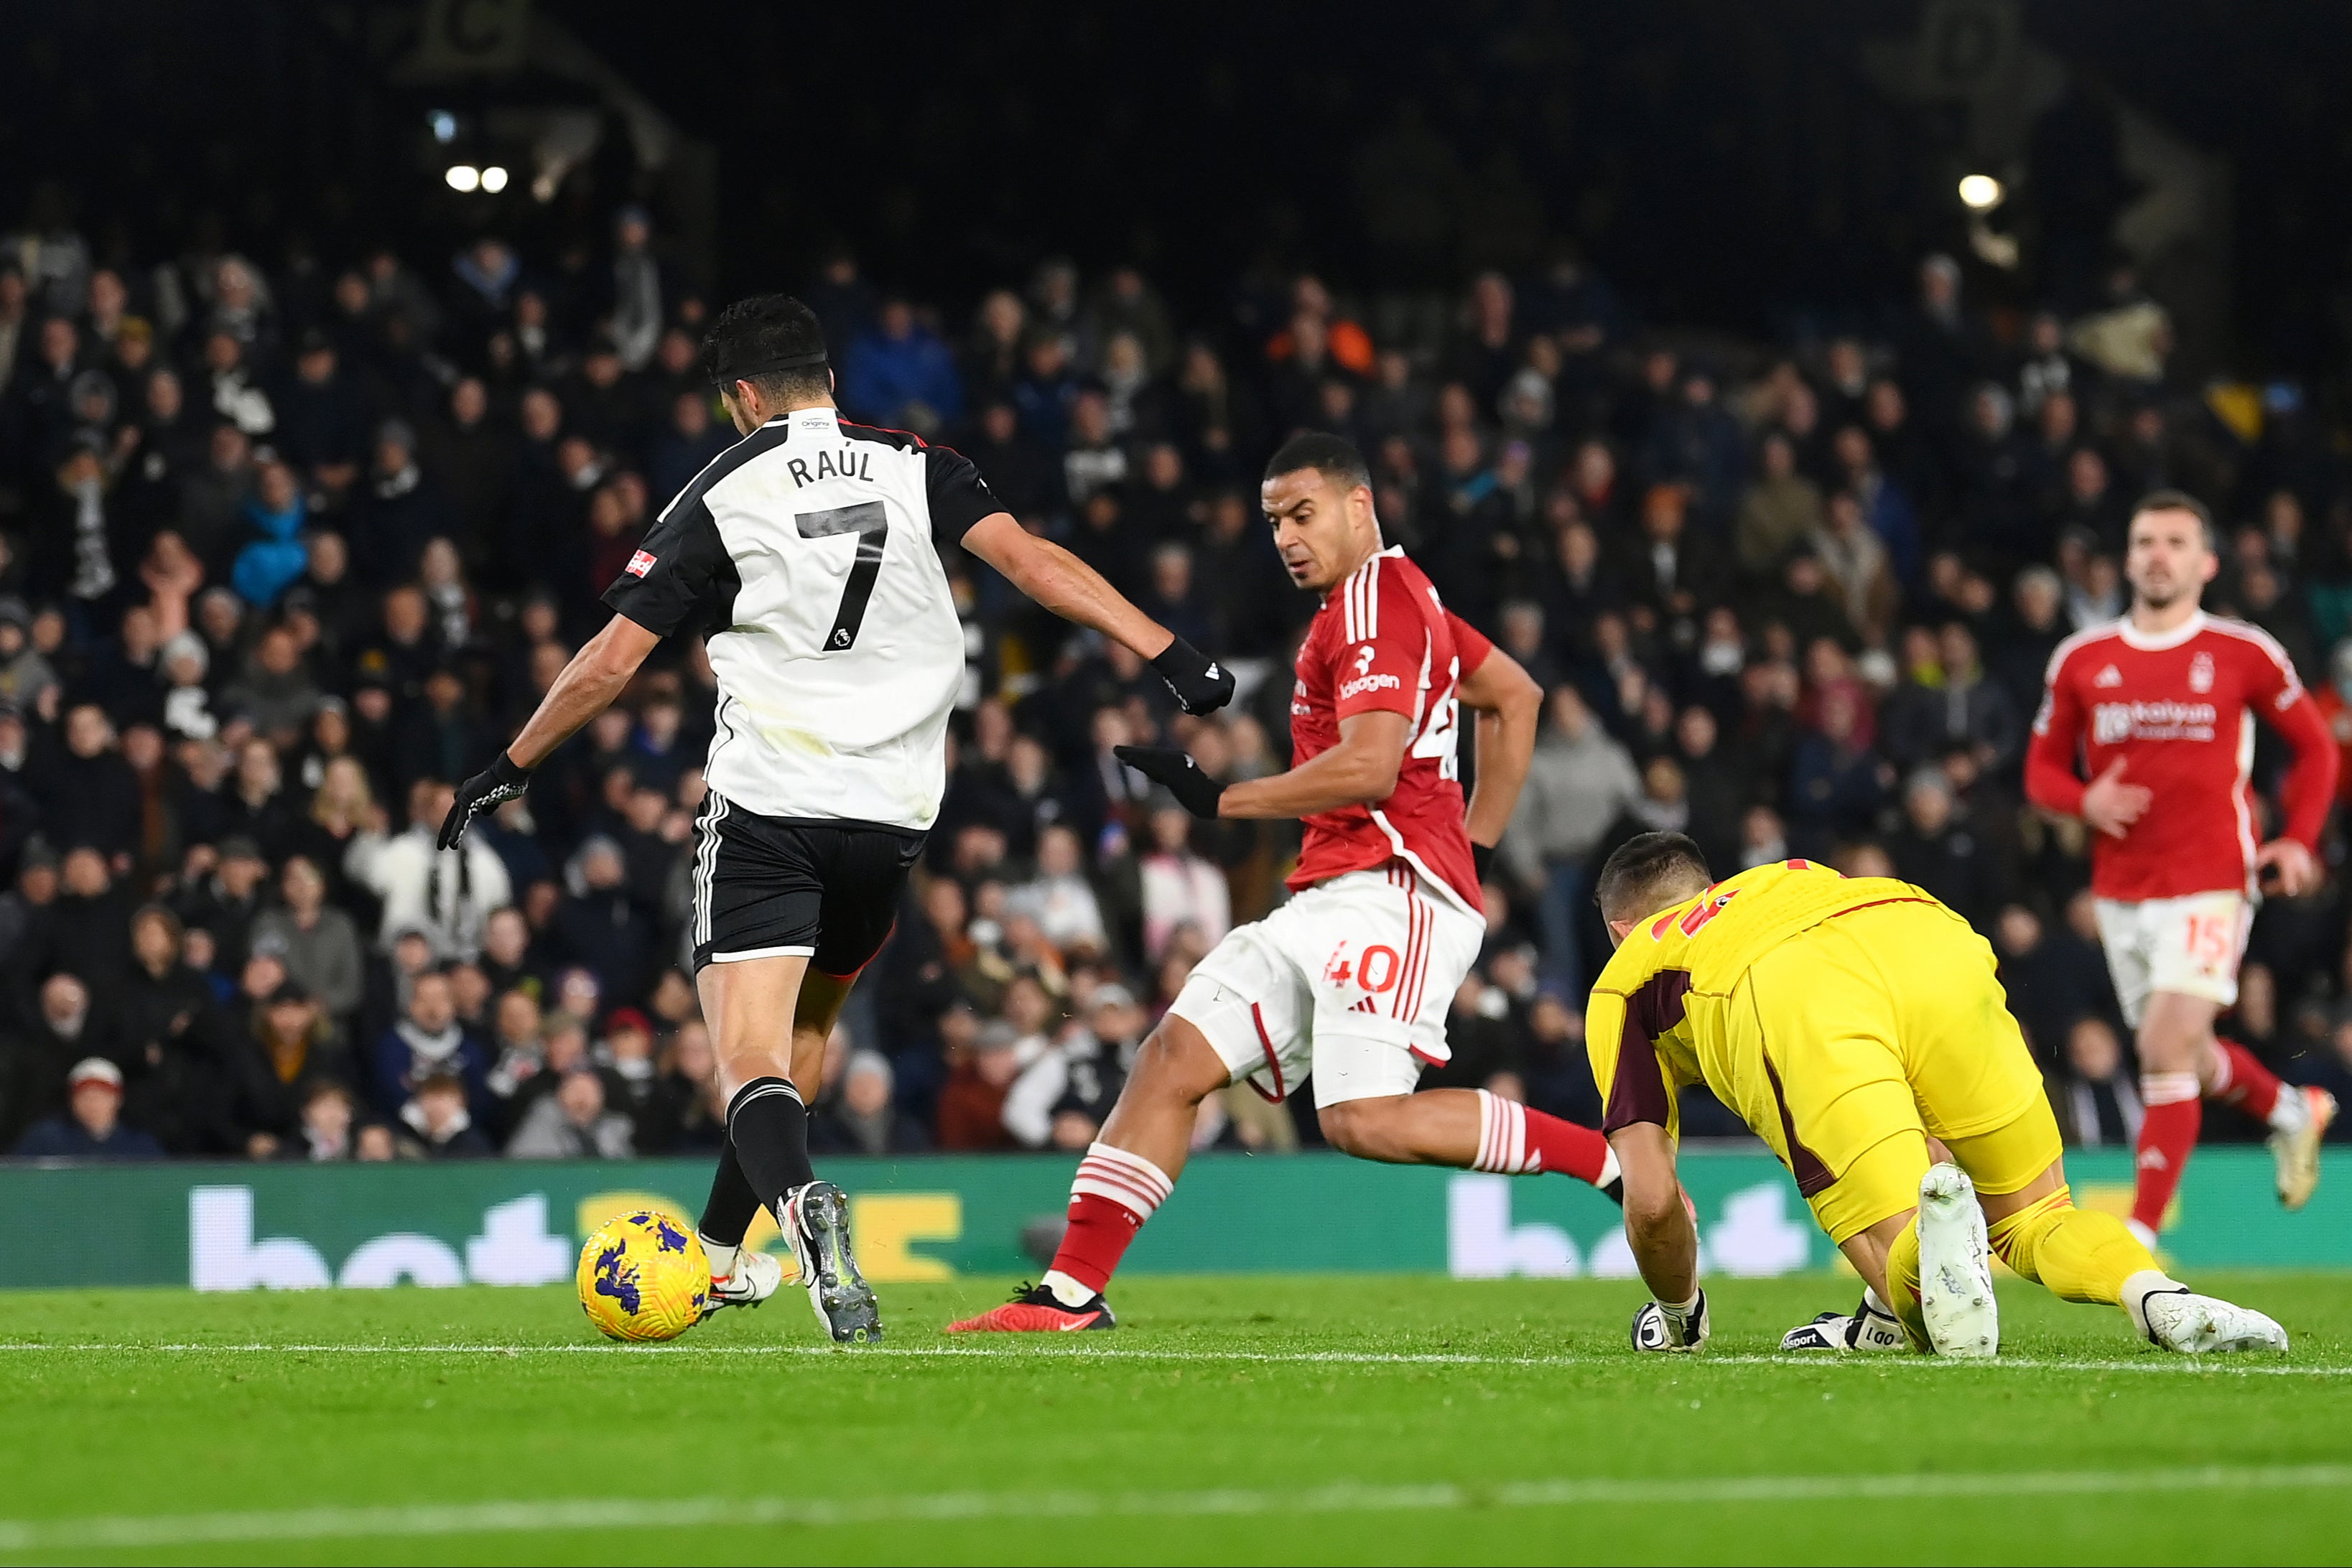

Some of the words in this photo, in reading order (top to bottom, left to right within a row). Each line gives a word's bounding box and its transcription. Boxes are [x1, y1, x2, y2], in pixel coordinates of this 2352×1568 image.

[787, 442, 874, 488] RAÚL
[794, 500, 889, 651] 7
[2187, 915, 2228, 961] 15
[1323, 940, 1400, 993] 40
